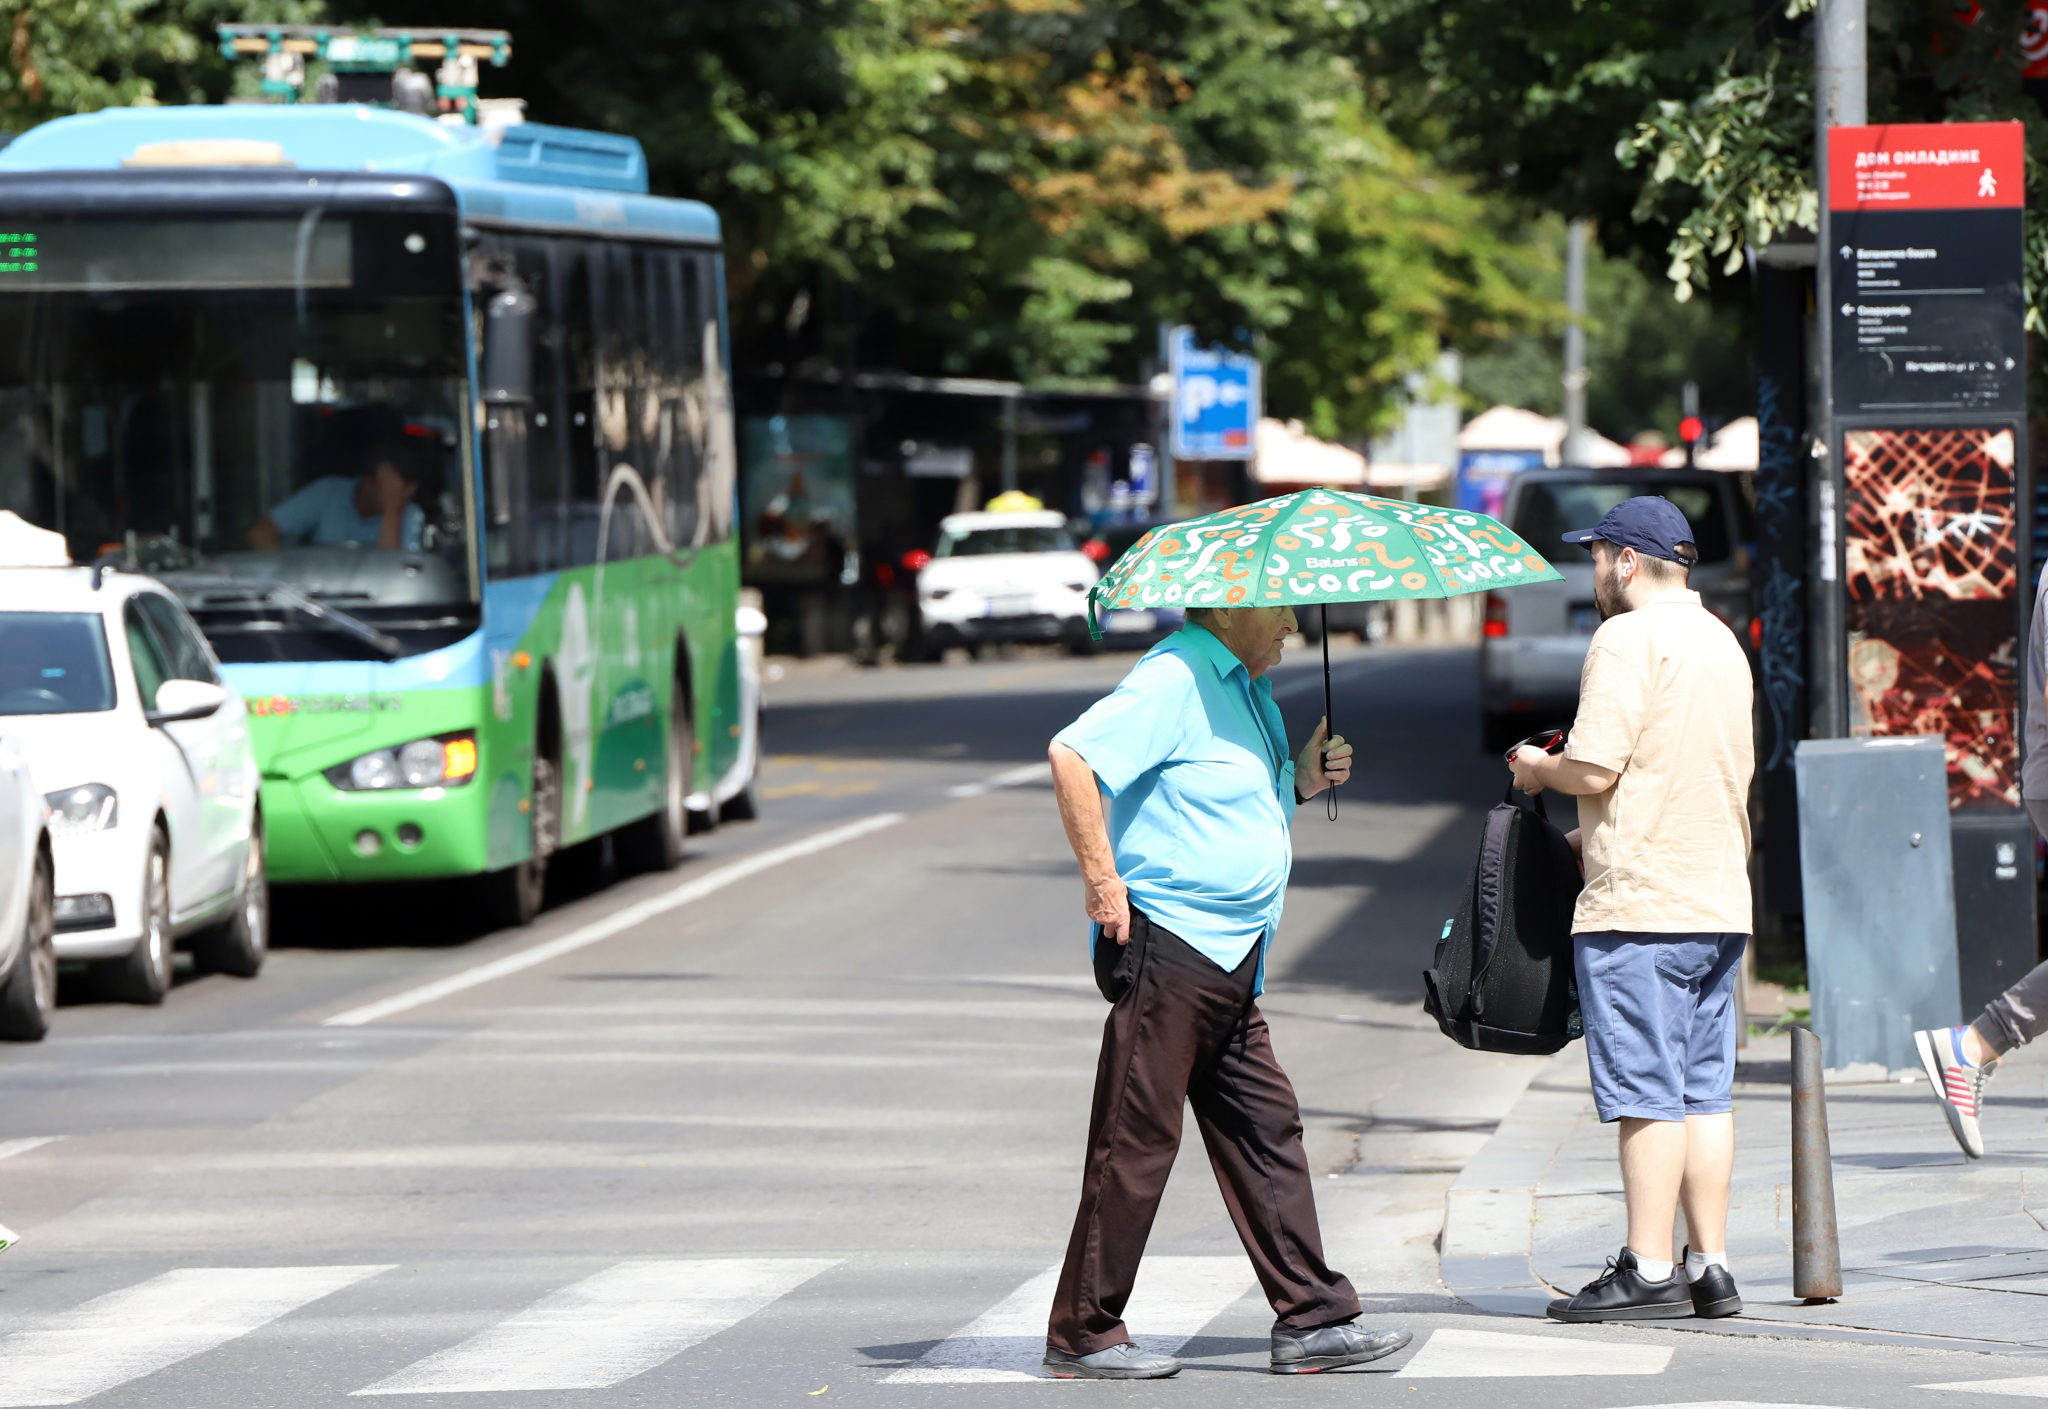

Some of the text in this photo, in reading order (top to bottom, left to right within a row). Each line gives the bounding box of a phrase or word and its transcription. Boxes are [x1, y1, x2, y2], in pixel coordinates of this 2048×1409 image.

[1855, 149, 1980, 168] ДОМ ОМЛАДИНЕ
[1185, 374, 1217, 422] P
[1305, 556, 1359, 569] Balans
